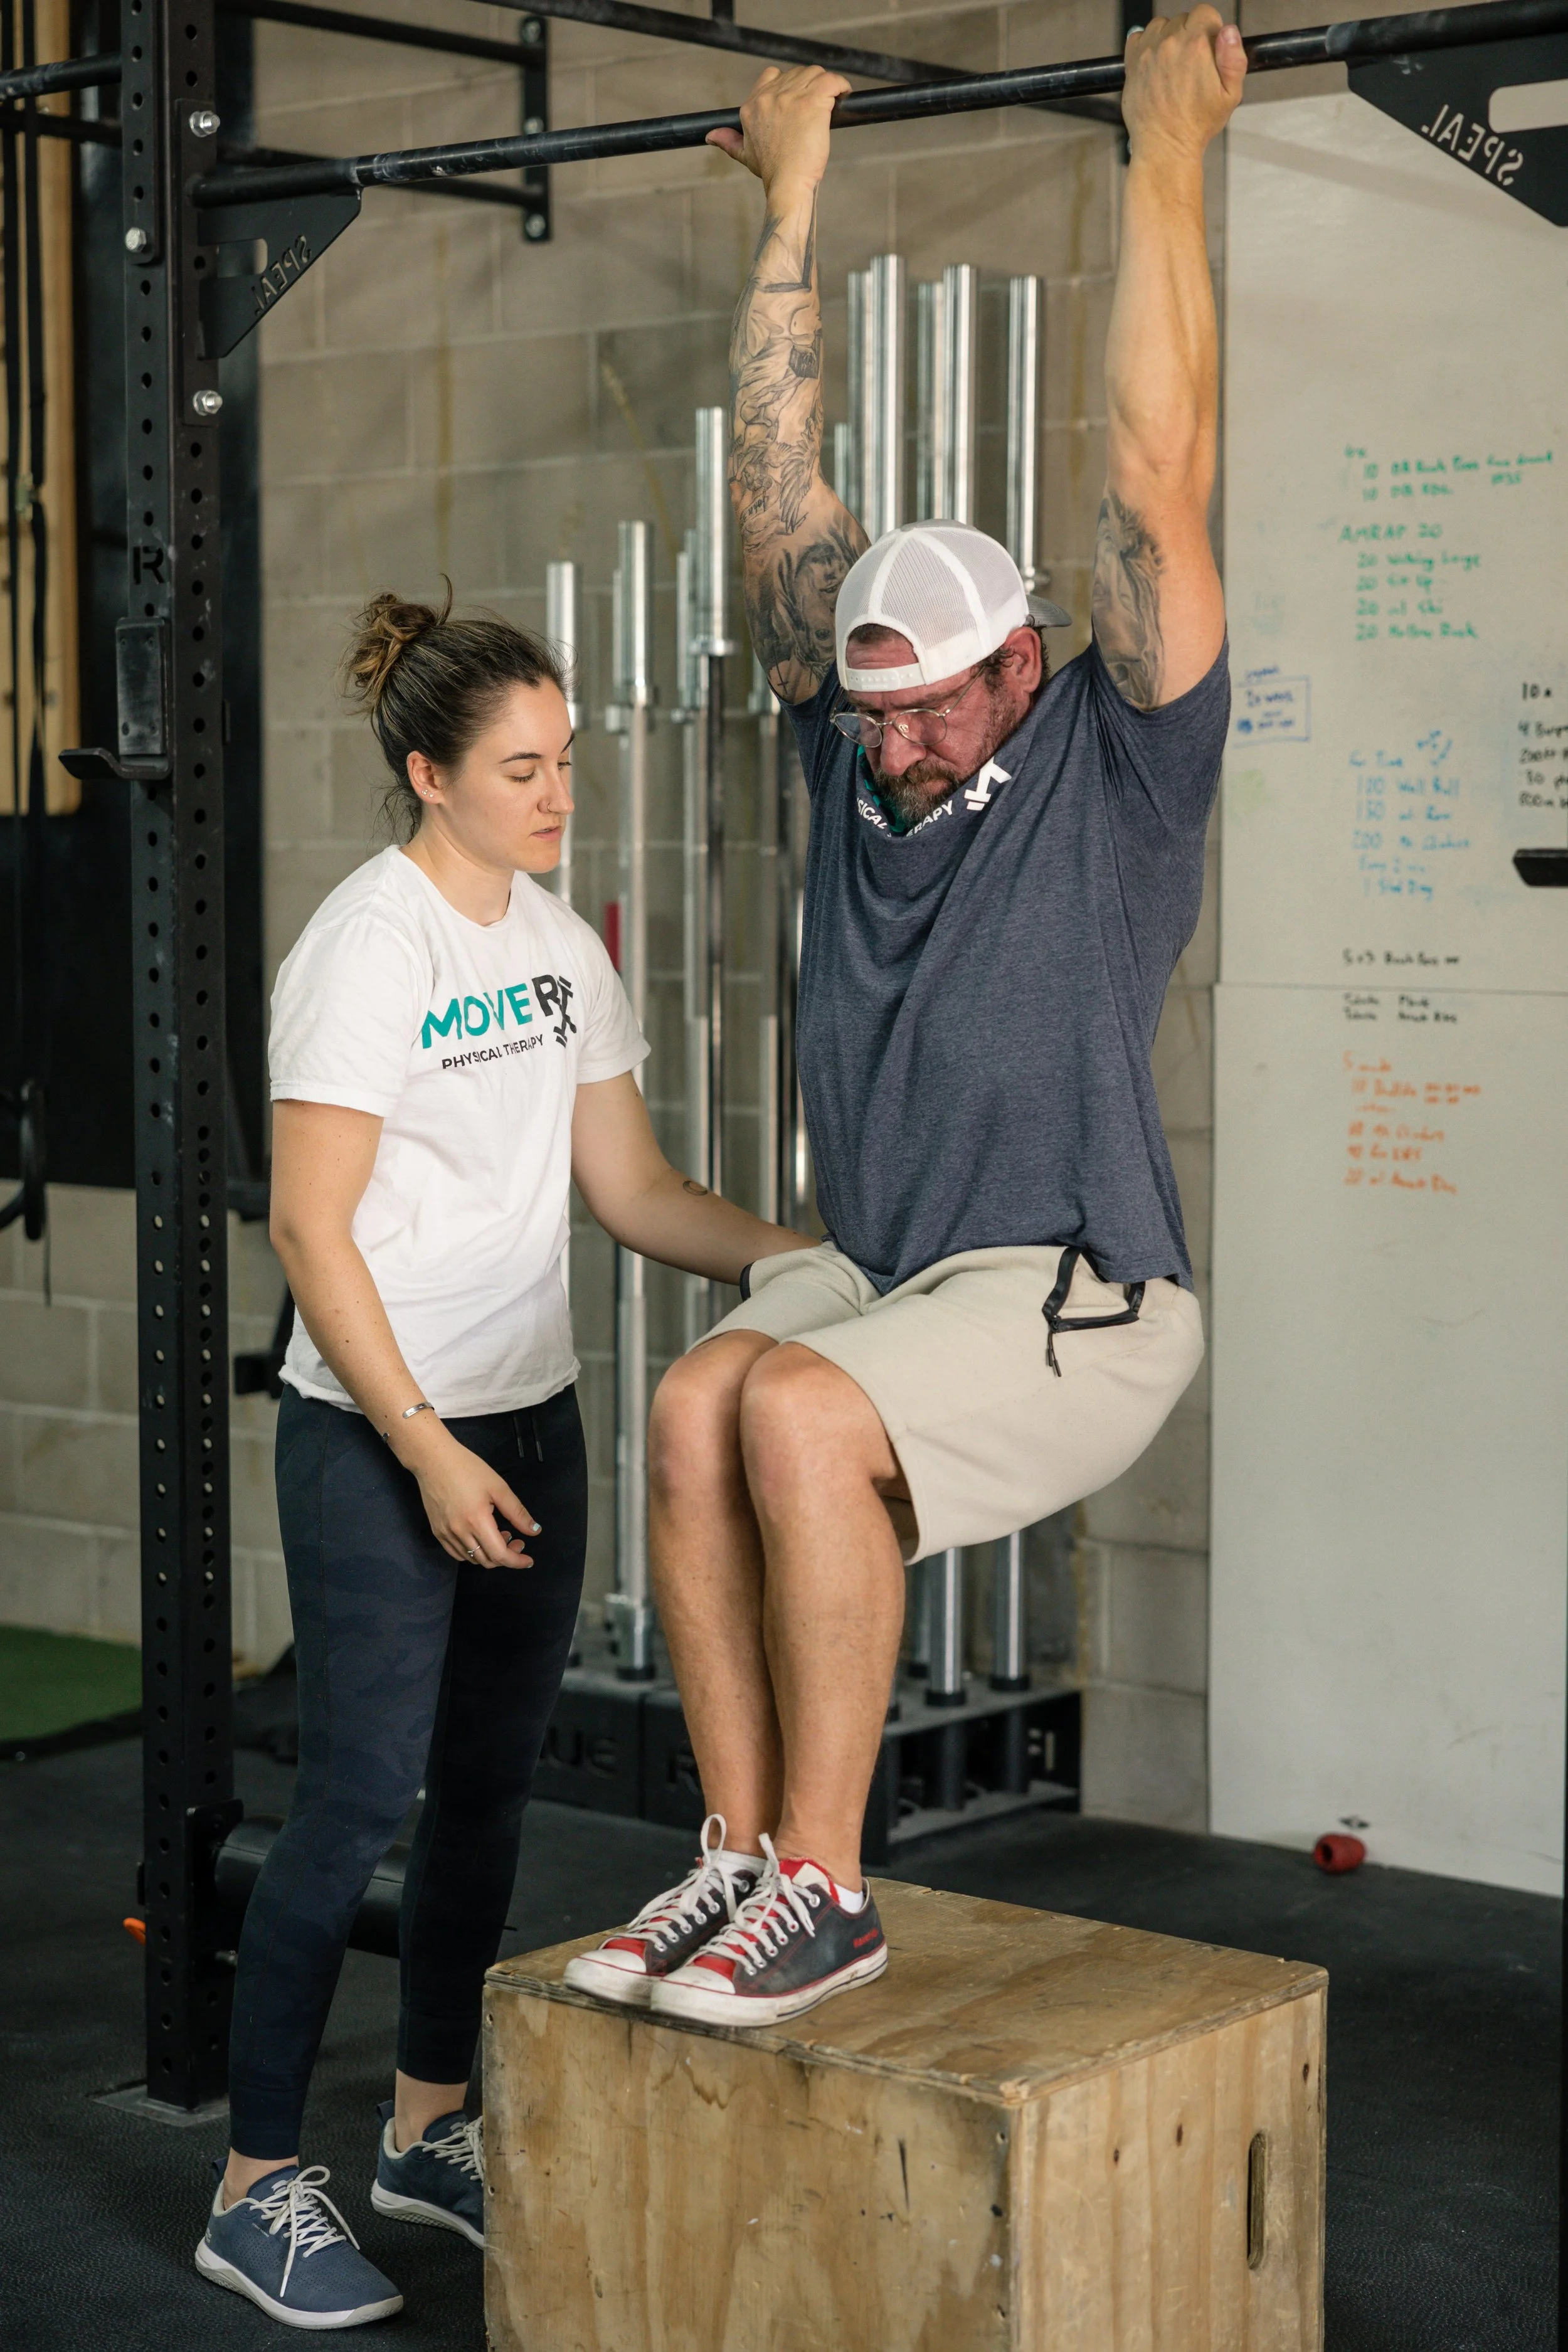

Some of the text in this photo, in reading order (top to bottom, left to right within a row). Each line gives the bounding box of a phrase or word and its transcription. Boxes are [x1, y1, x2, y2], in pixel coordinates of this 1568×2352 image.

[132, 546, 165, 585] R
[857, 797, 953, 837] SICAL ERAPY
[442, 1034, 544, 1069] PHYSICAL THERAPY
[539, 1726, 618, 1775] UE
